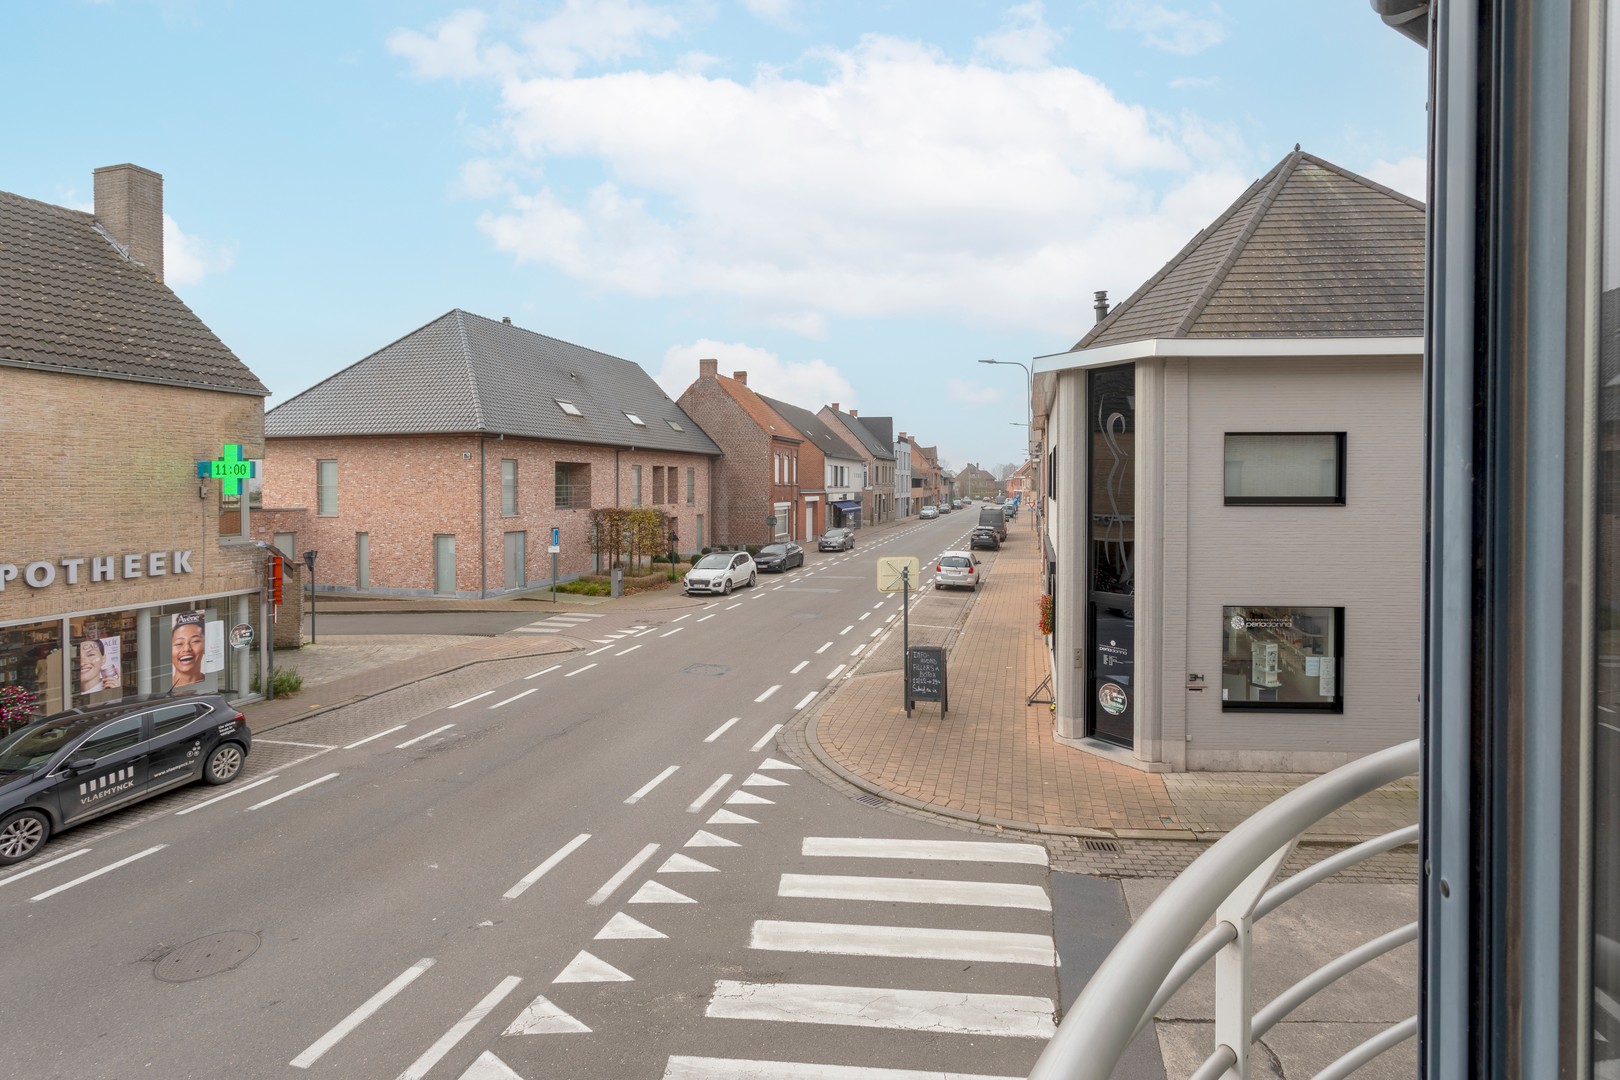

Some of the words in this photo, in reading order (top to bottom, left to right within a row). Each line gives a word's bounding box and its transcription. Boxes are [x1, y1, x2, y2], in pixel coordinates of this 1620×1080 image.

[215, 463, 247, 476] 11:00
[1188, 673, 1205, 682] 34
[80, 779, 135, 805] VLAEMYNCK
